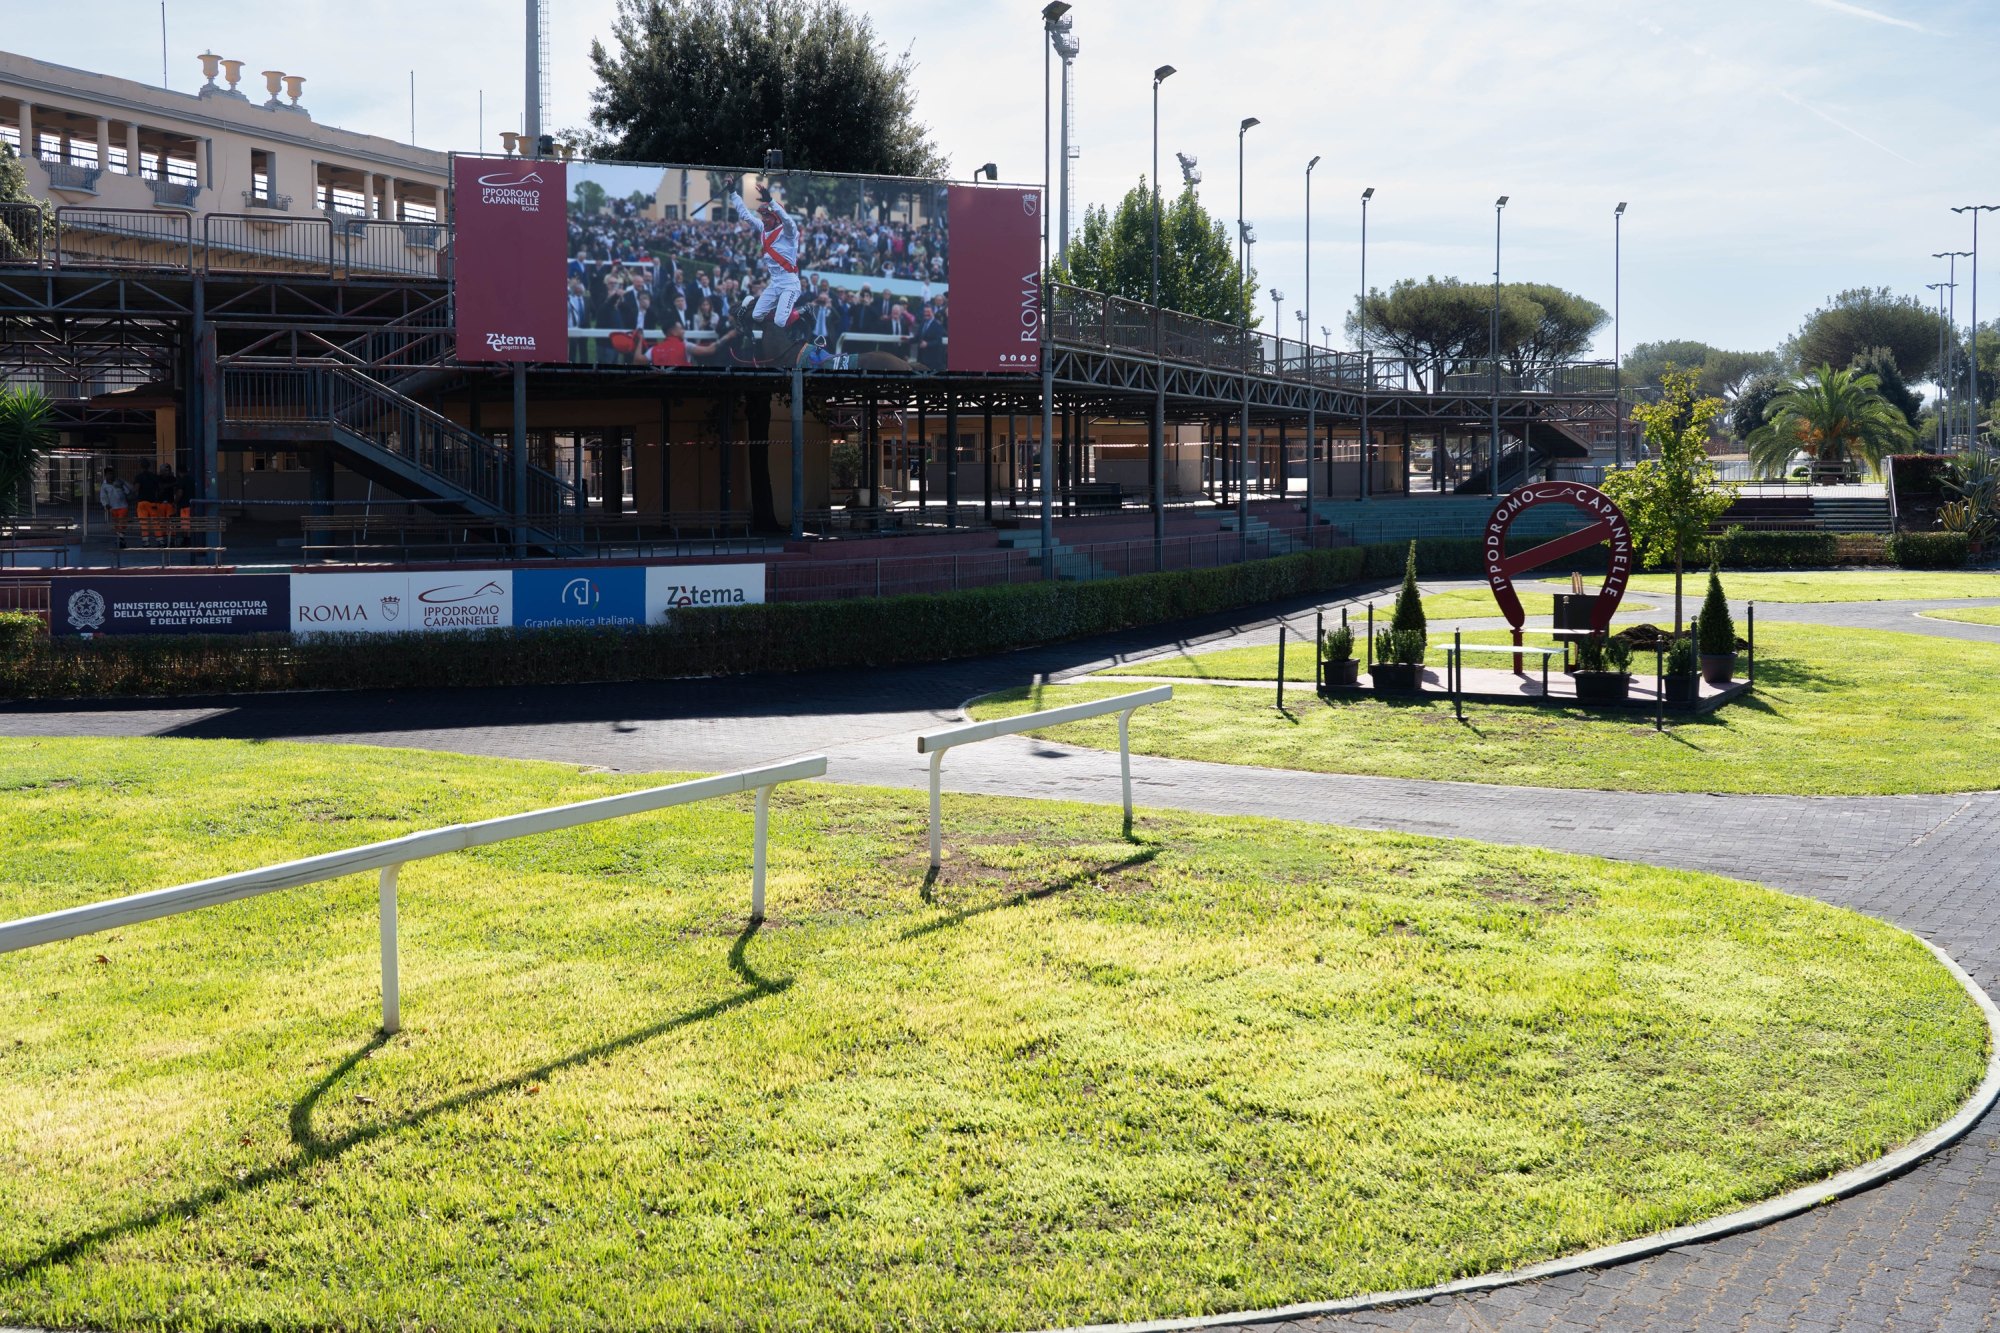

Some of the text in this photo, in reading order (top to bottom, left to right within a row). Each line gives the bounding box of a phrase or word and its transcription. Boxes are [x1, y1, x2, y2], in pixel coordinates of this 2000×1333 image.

[482, 188, 540, 198] IPPODROMO
[482, 196, 540, 206] CAPANNELLE
[1020, 271, 1038, 342] ROMA
[486, 333, 536, 351] Zètema
[1487, 489, 1628, 597] IPPODROMO CAPANNELLE
[113, 600, 268, 610] MINISTERO DELL'AGRICOLTURA
[424, 605, 499, 617] IPPODROMO
[113, 607, 268, 618] DELLA SOVRANITÀ ALIMENTARE
[299, 604, 368, 622] ROMA
[150, 616, 233, 625] E DELLE FORESTE
[424, 615, 499, 627] CAPANNELLE
[524, 617, 562, 628] Grande
[598, 615, 635, 625] Italiana
